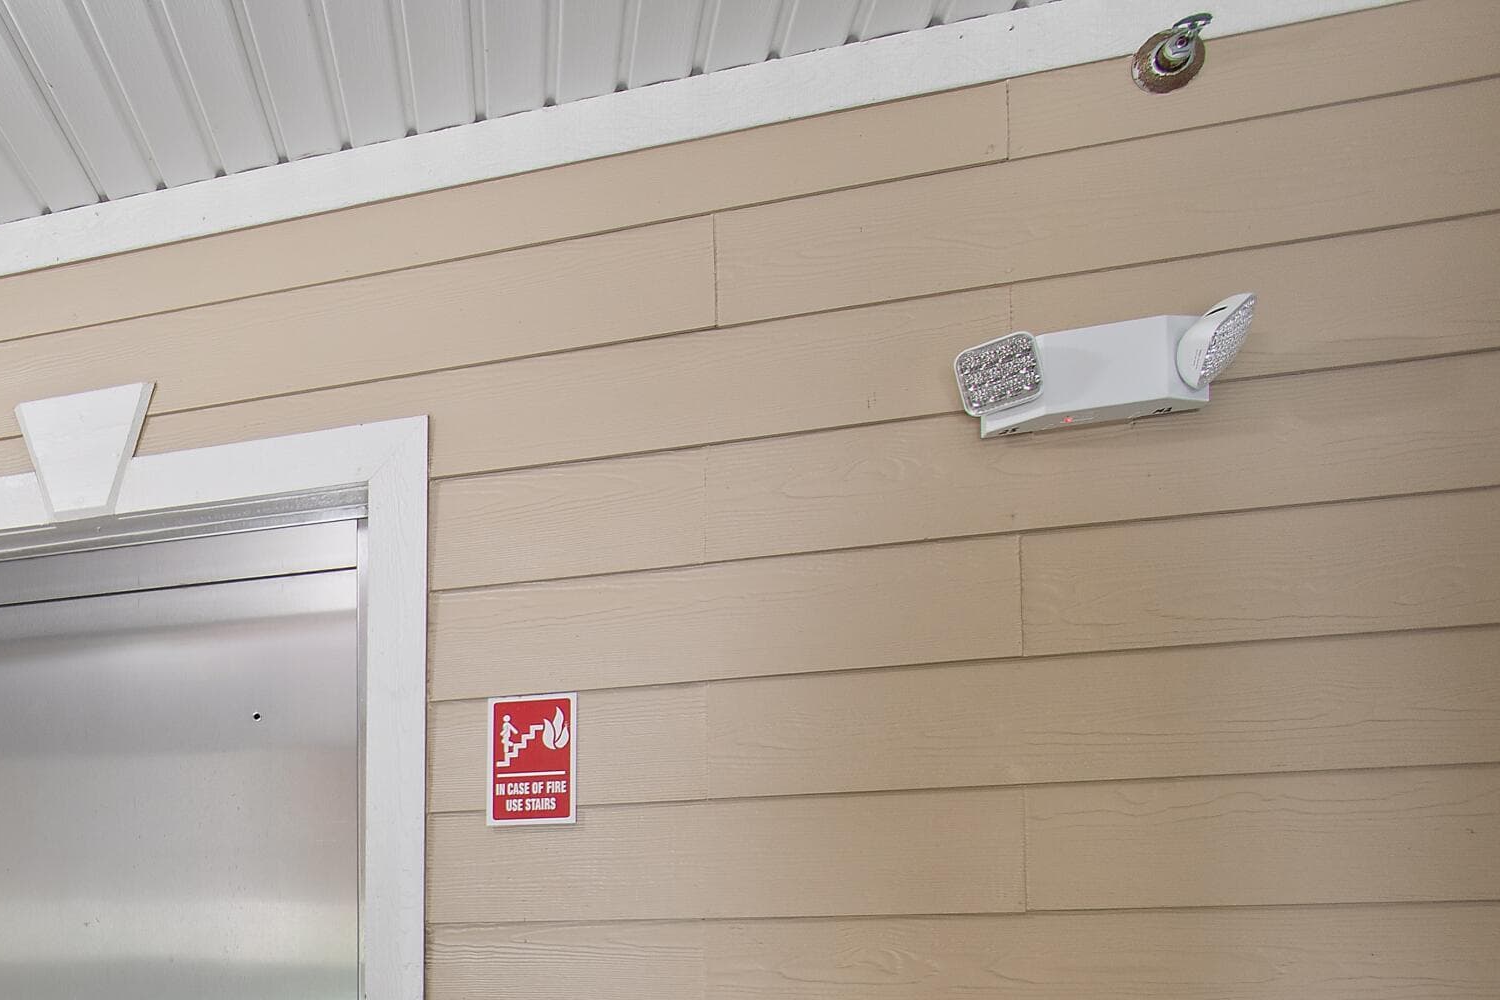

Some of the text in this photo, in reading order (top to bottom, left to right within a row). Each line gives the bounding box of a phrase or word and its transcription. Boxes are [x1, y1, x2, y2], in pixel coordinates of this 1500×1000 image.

[496, 780, 567, 795] IN CASE OF FIRE
[506, 797, 556, 811] USE STAIRS
